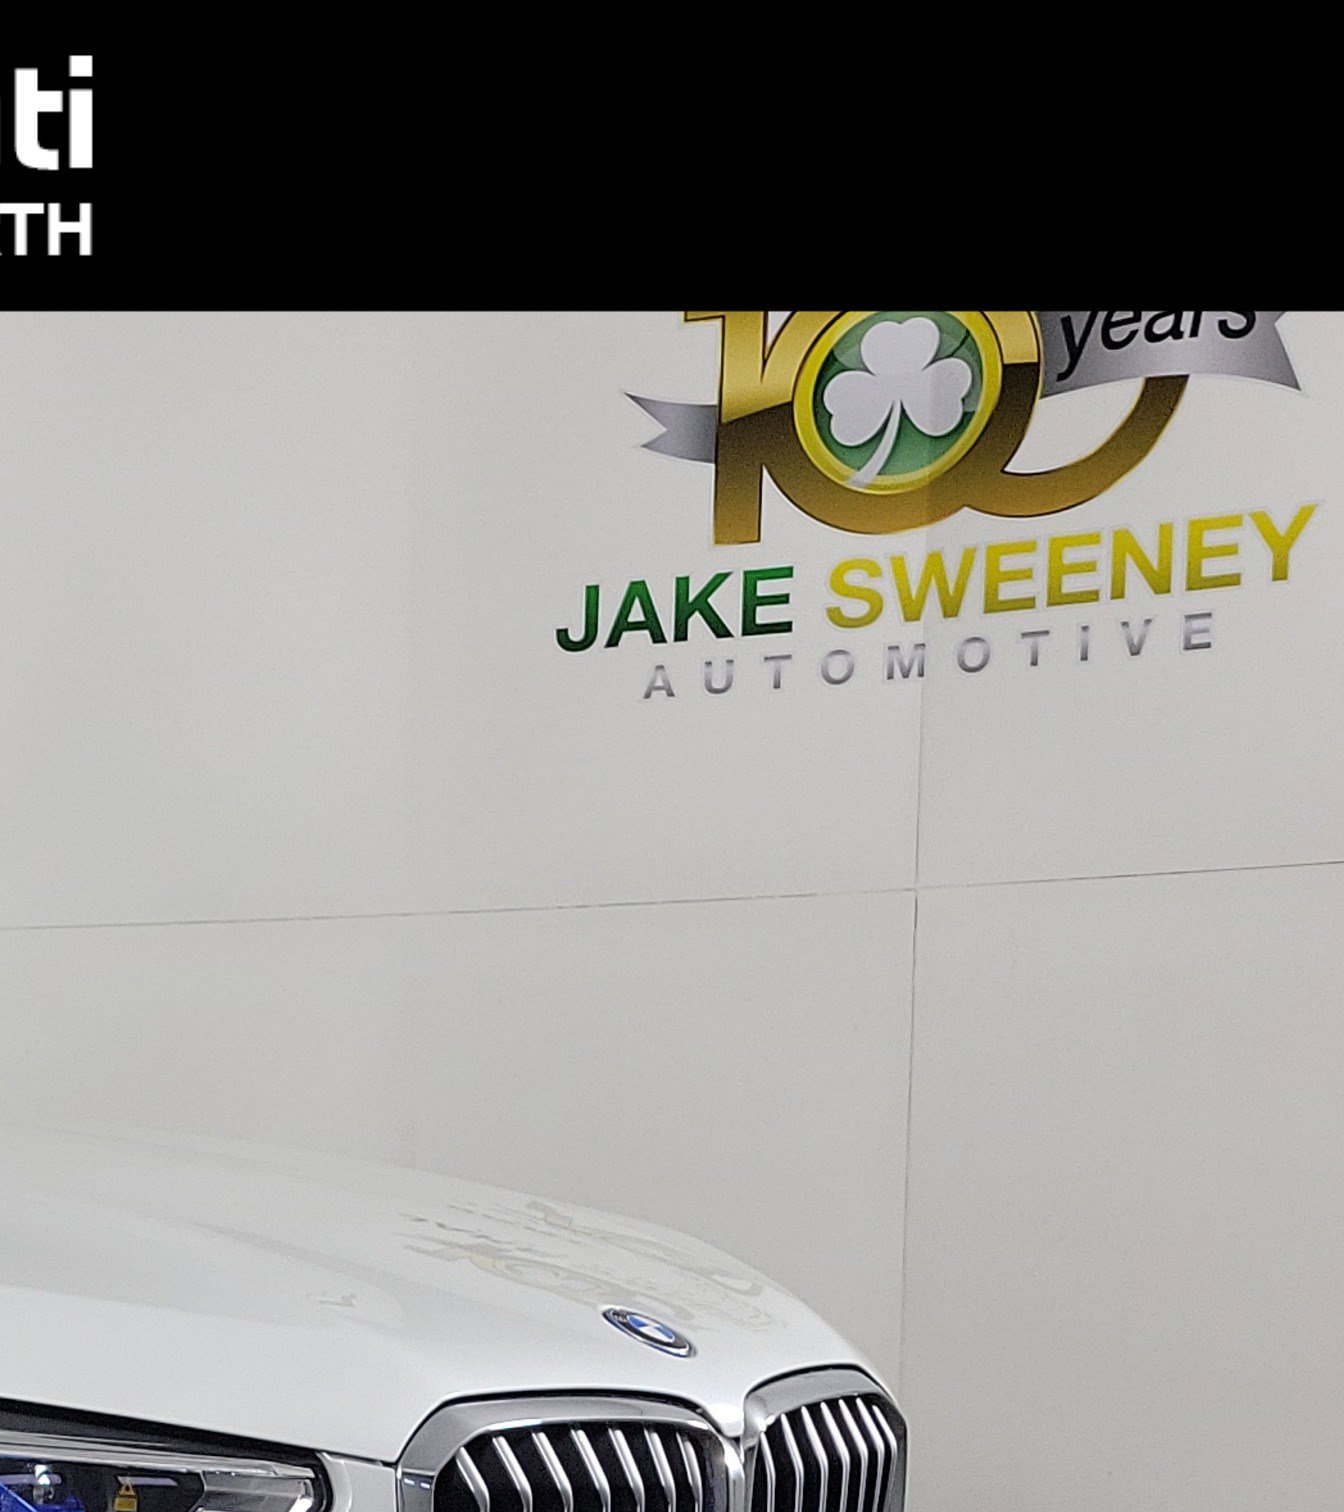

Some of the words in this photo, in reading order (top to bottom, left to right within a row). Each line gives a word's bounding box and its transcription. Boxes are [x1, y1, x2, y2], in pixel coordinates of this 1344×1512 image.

[555, 566, 795, 653] JAKE
[825, 504, 1319, 629] SWEENEY
[643, 612, 1214, 699] AUTOMOTIVE
